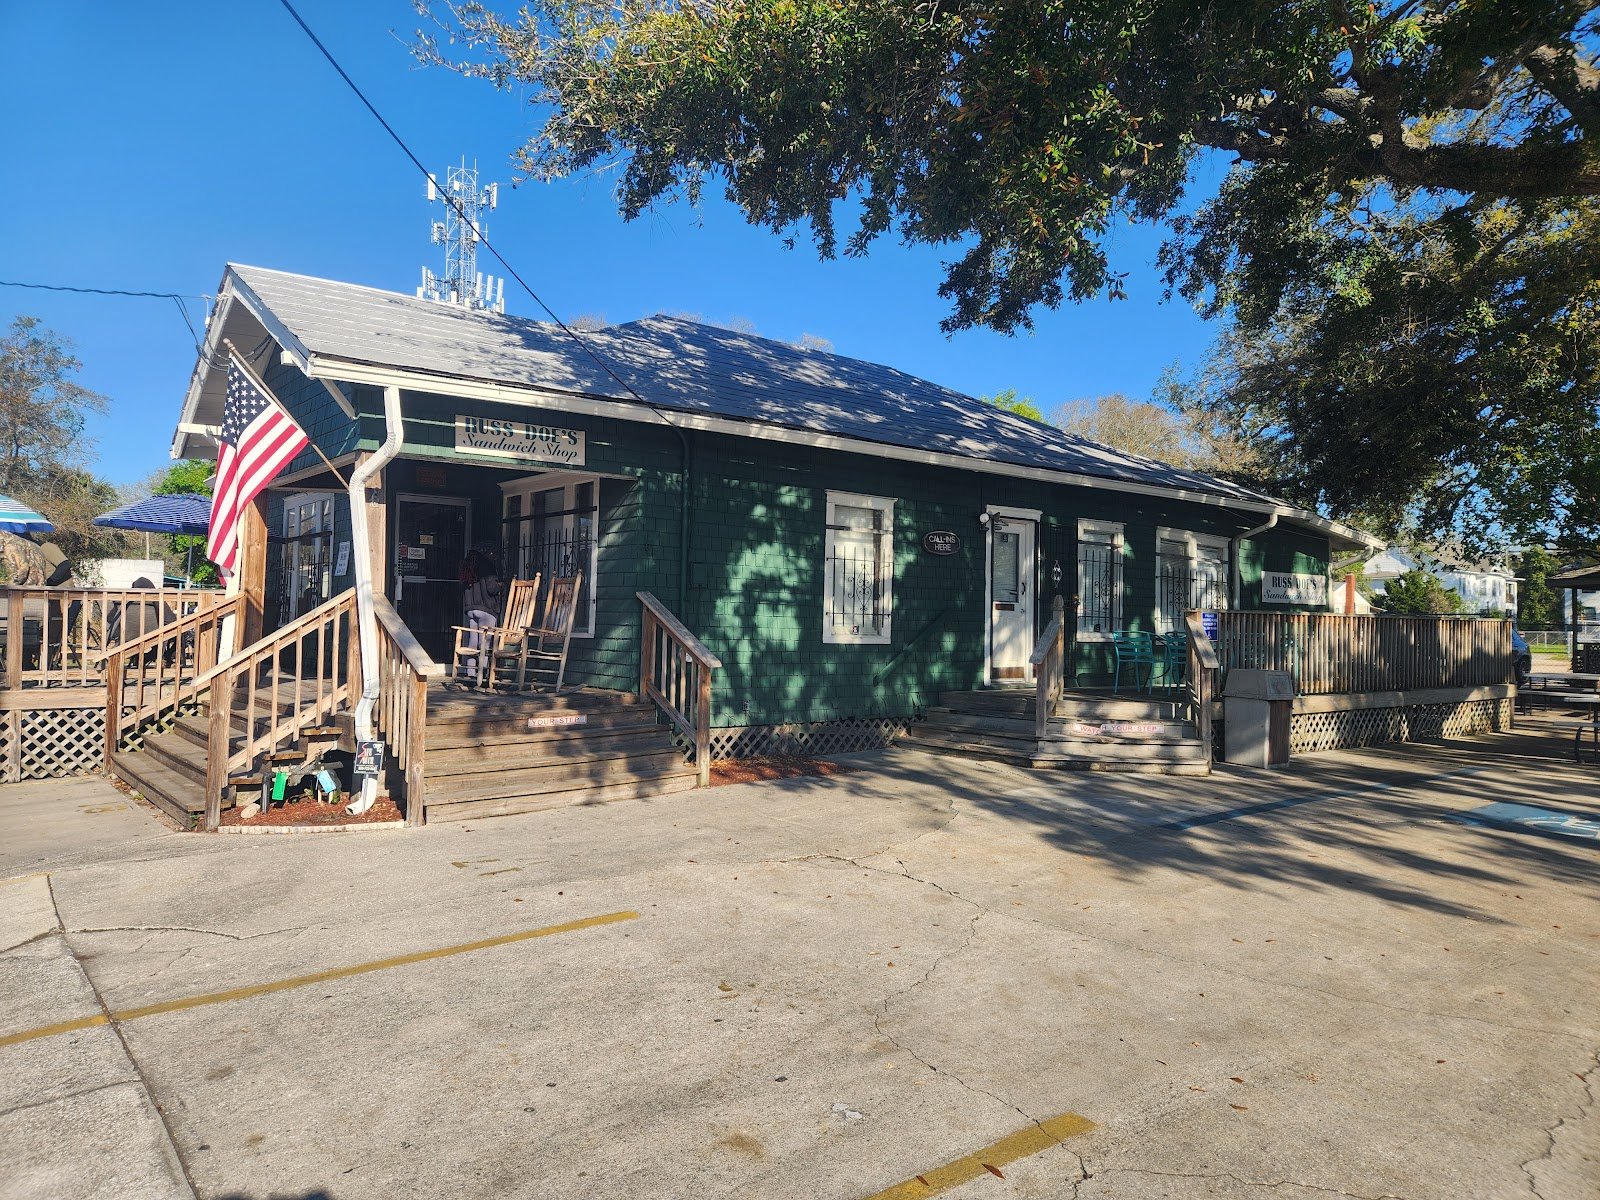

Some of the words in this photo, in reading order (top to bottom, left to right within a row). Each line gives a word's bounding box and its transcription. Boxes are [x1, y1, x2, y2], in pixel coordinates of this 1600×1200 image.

[465, 416, 514, 438] RUSS
[525, 423, 578, 446] DOE'S
[462, 433, 537, 454] Sandwich
[542, 442, 578, 462] Shop
[934, 543, 952, 552] HERE
[1272, 575, 1292, 589] RUSS
[531, 718, 555, 727] YOUR
[1138, 725, 1157, 733] STEP
